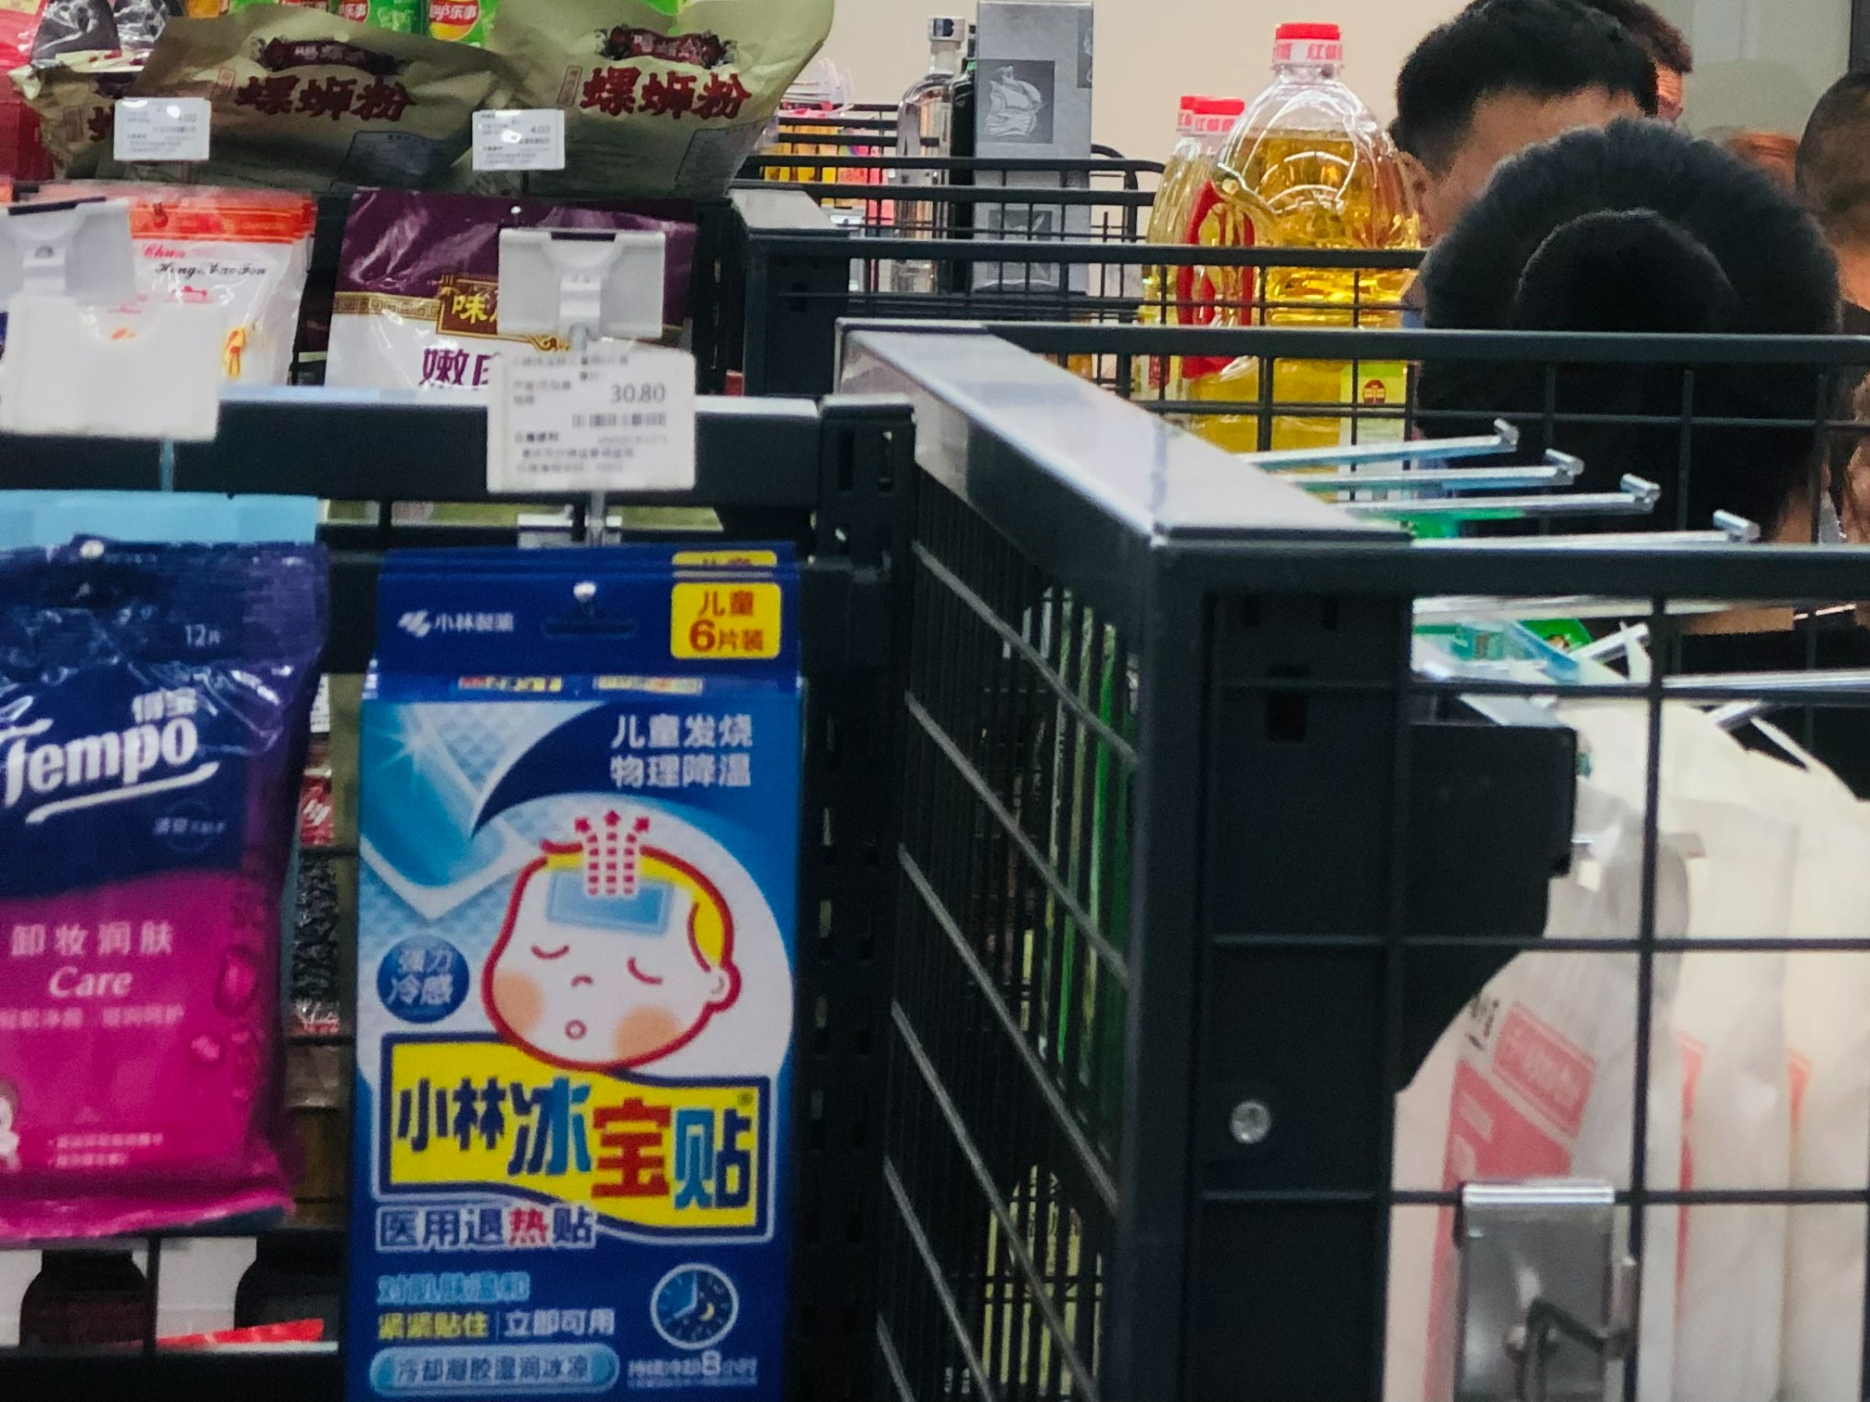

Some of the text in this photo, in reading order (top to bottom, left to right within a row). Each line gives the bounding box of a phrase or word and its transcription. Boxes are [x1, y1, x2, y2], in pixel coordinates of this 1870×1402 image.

[451, 292, 498, 324] 味
[697, 589, 755, 616] 儿童
[688, 619, 764, 653] 6片装
[611, 713, 752, 748] 儿童发烧
[0, 716, 199, 809] Tempo
[610, 752, 751, 788] 物理降温
[49, 965, 133, 998] Care
[389, 974, 454, 1005] 冷感
[397, 1077, 753, 1211] 小林冰宝贴
[379, 1207, 593, 1249] 医用退热贴
[503, 1307, 616, 1338] 立即可用
